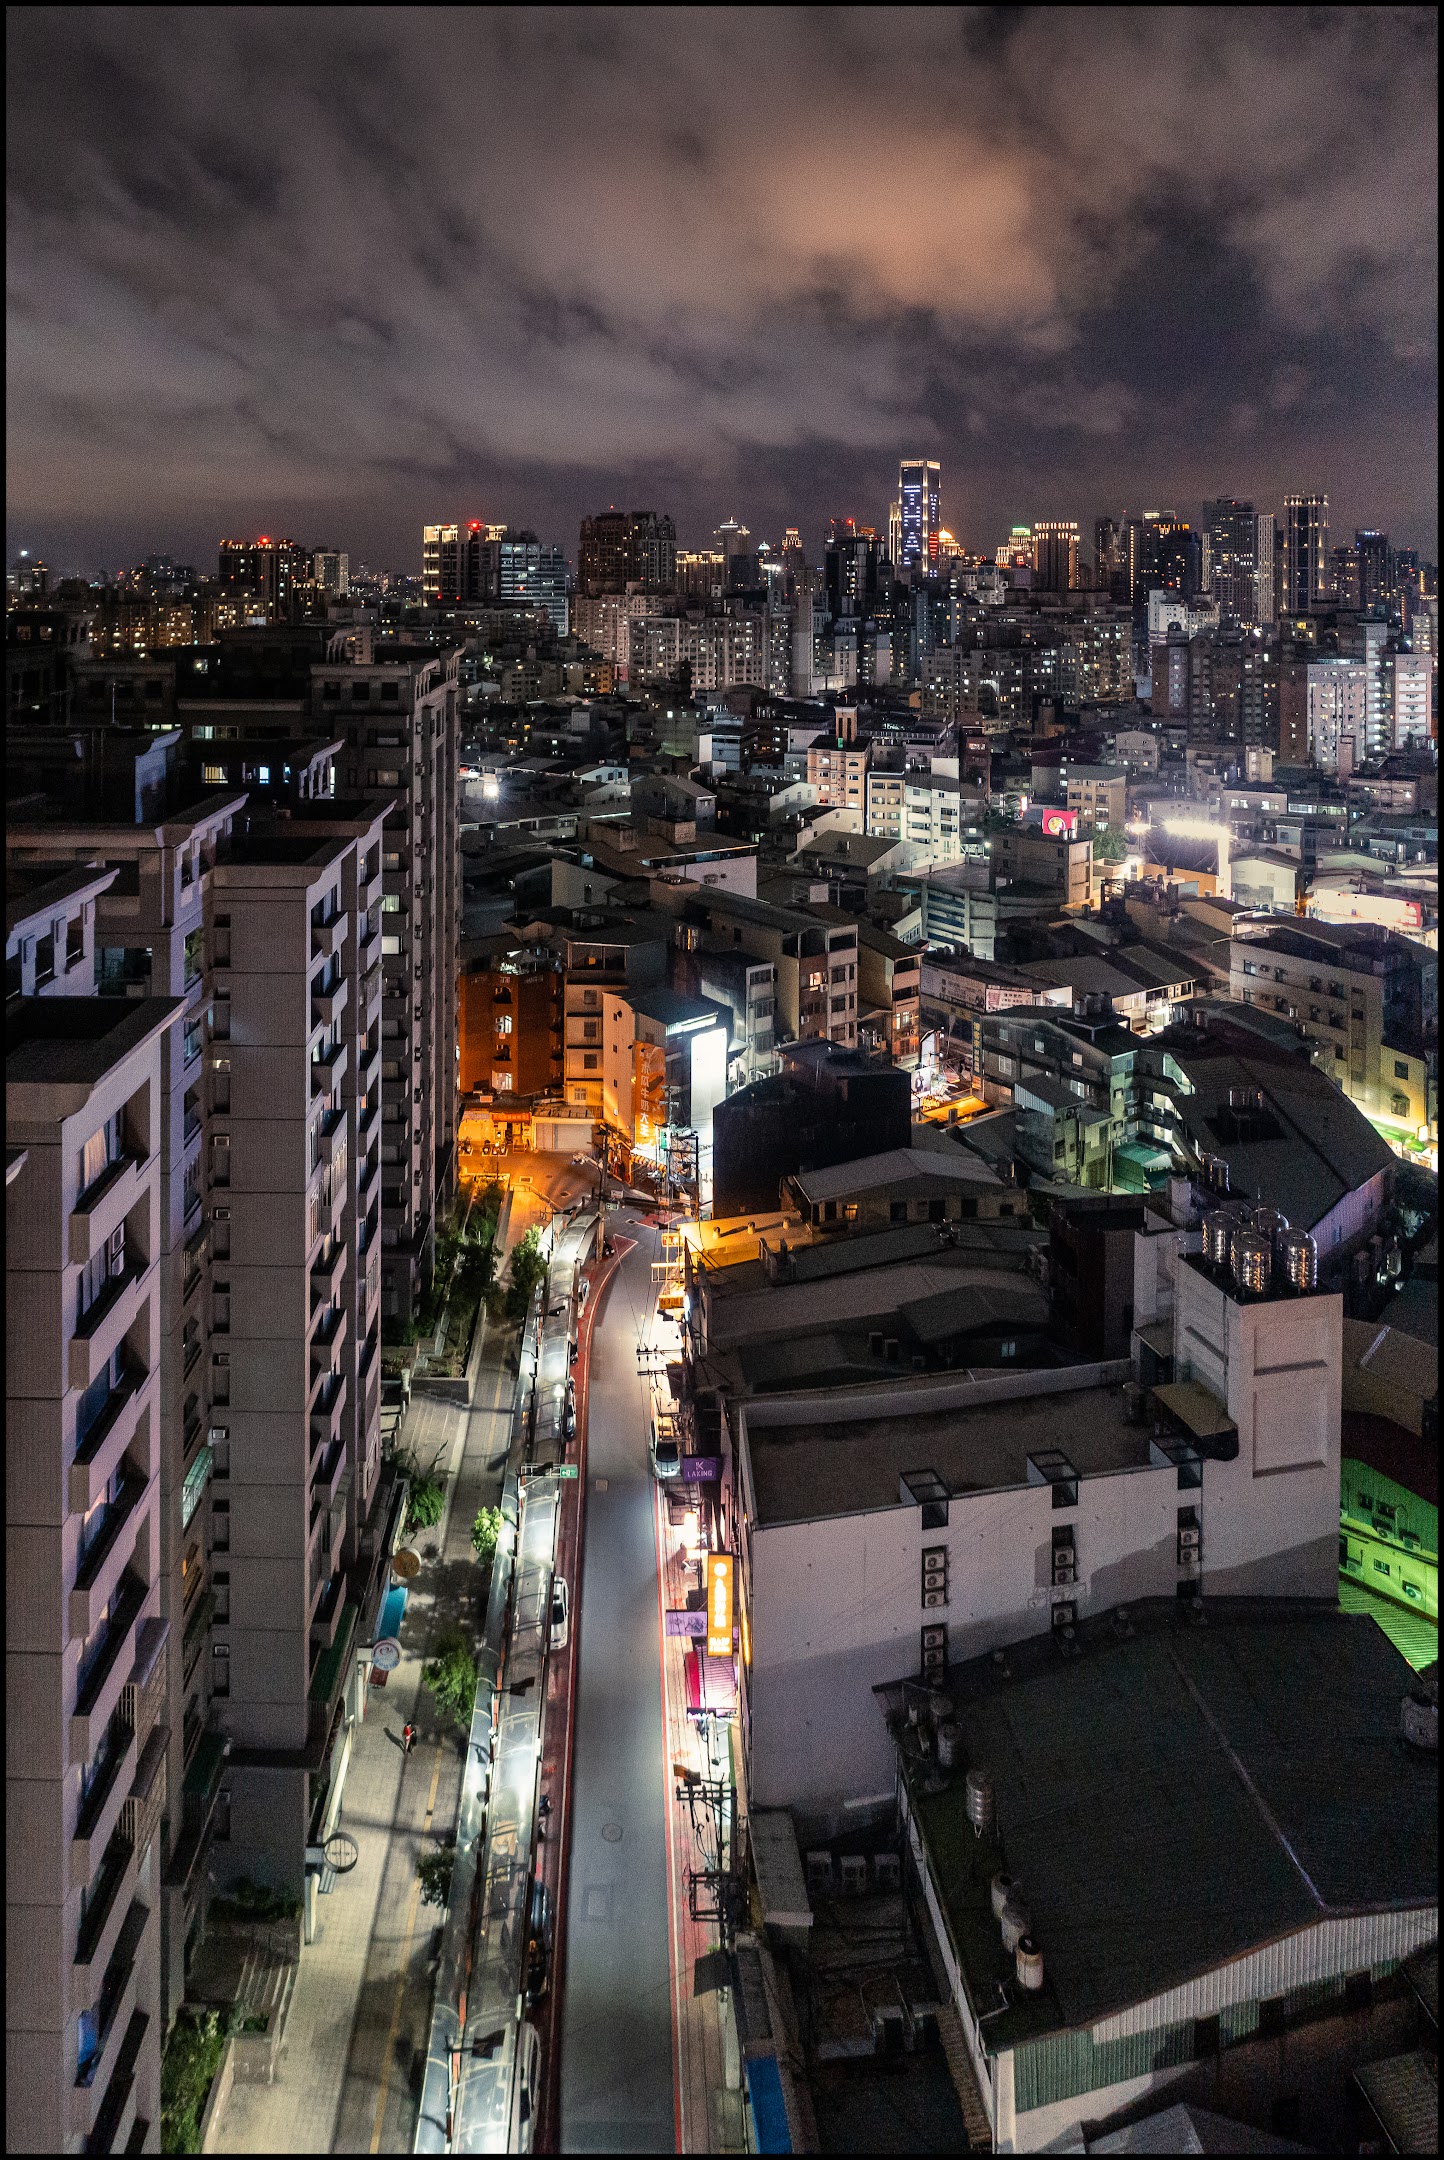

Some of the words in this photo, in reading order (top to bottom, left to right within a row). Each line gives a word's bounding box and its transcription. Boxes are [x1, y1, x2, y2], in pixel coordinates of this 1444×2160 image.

[640, 1062, 650, 1137] 木瓜牛奶大王
